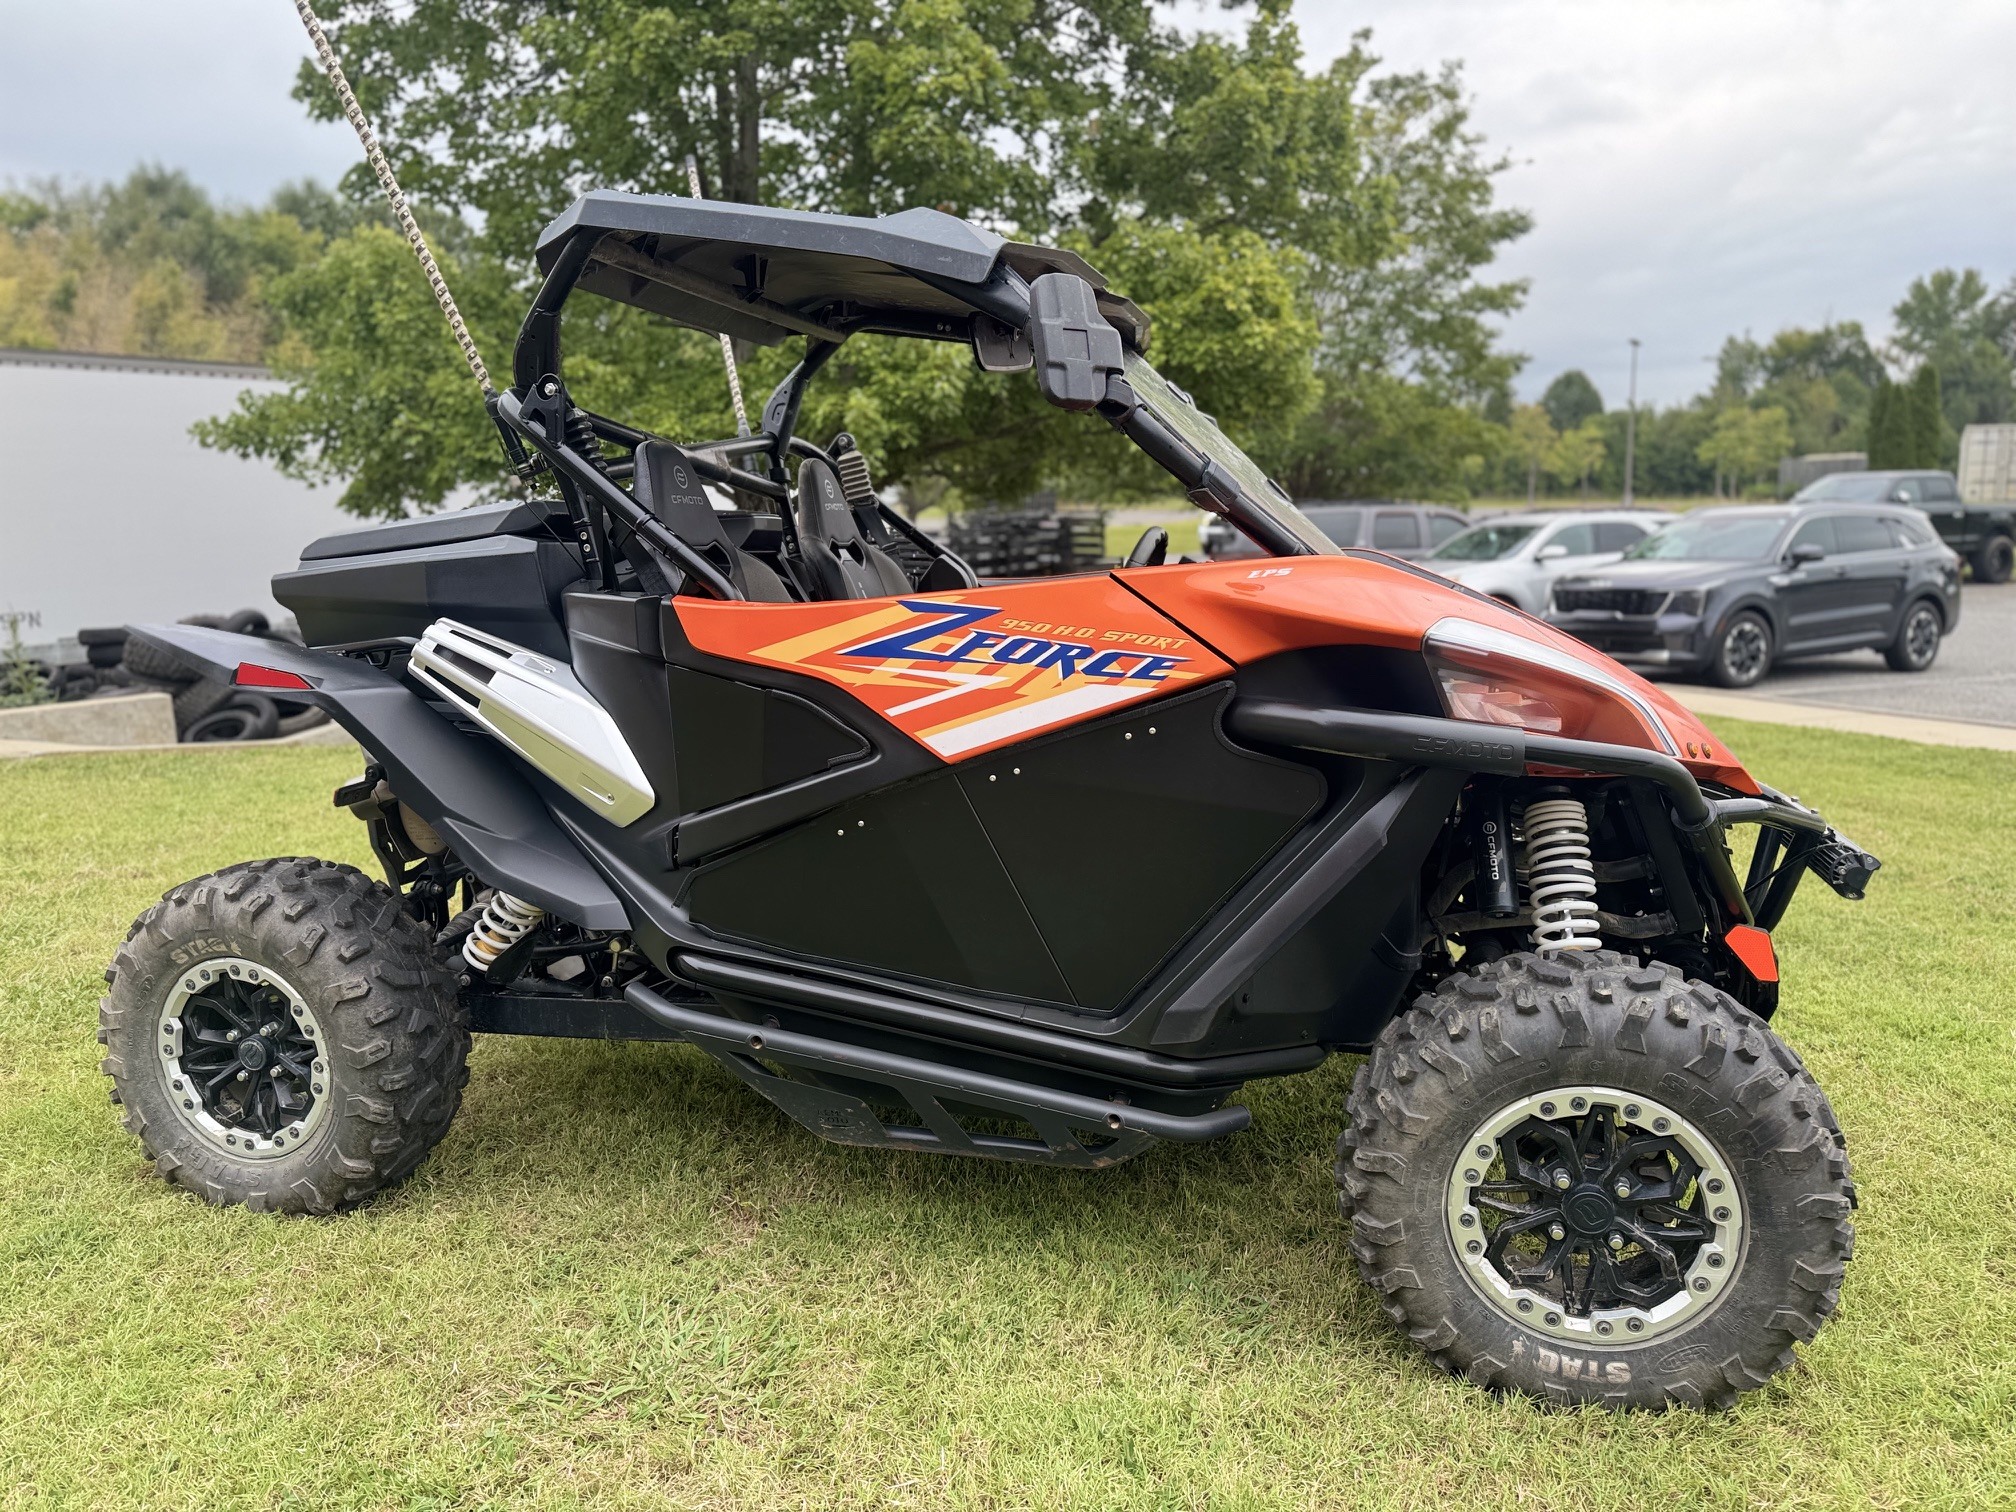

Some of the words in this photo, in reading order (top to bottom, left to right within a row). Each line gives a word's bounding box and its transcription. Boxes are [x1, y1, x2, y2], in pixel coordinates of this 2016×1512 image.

[671, 494, 703, 505] CFMOTO
[1246, 567, 1294, 579] EPS
[999, 618, 1053, 633] 950
[1051, 625, 1097, 639] H.O.
[1099, 630, 1191, 651] SPORT
[1413, 735, 1515, 760] CFMOTO
[1487, 835, 1500, 880] CFMOTO
[1533, 1346, 1632, 1384] STAG
